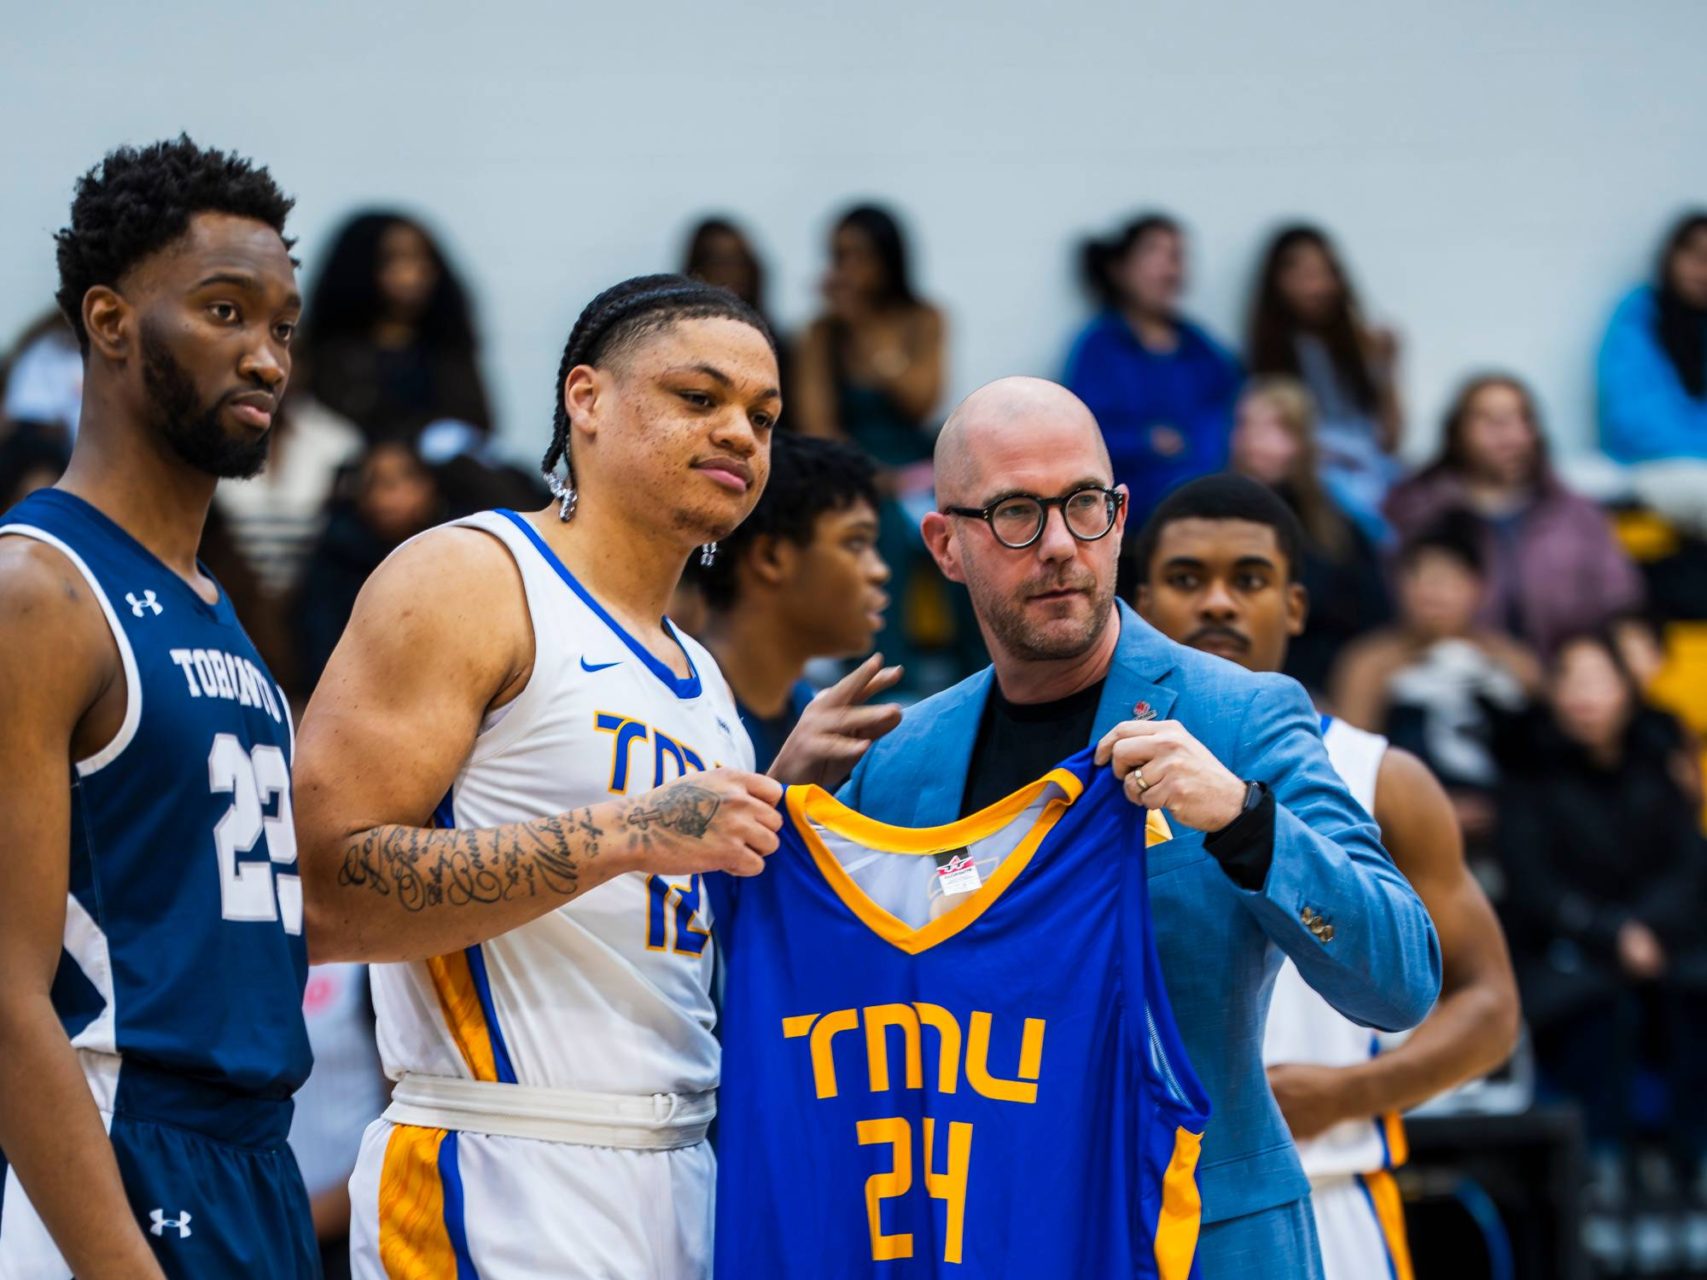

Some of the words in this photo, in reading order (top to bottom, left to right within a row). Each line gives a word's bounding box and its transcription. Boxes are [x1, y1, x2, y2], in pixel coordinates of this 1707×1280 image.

[169, 648, 282, 724] TORONTO
[781, 1001, 1046, 1104] TMU
[855, 1116, 973, 1264] 24
